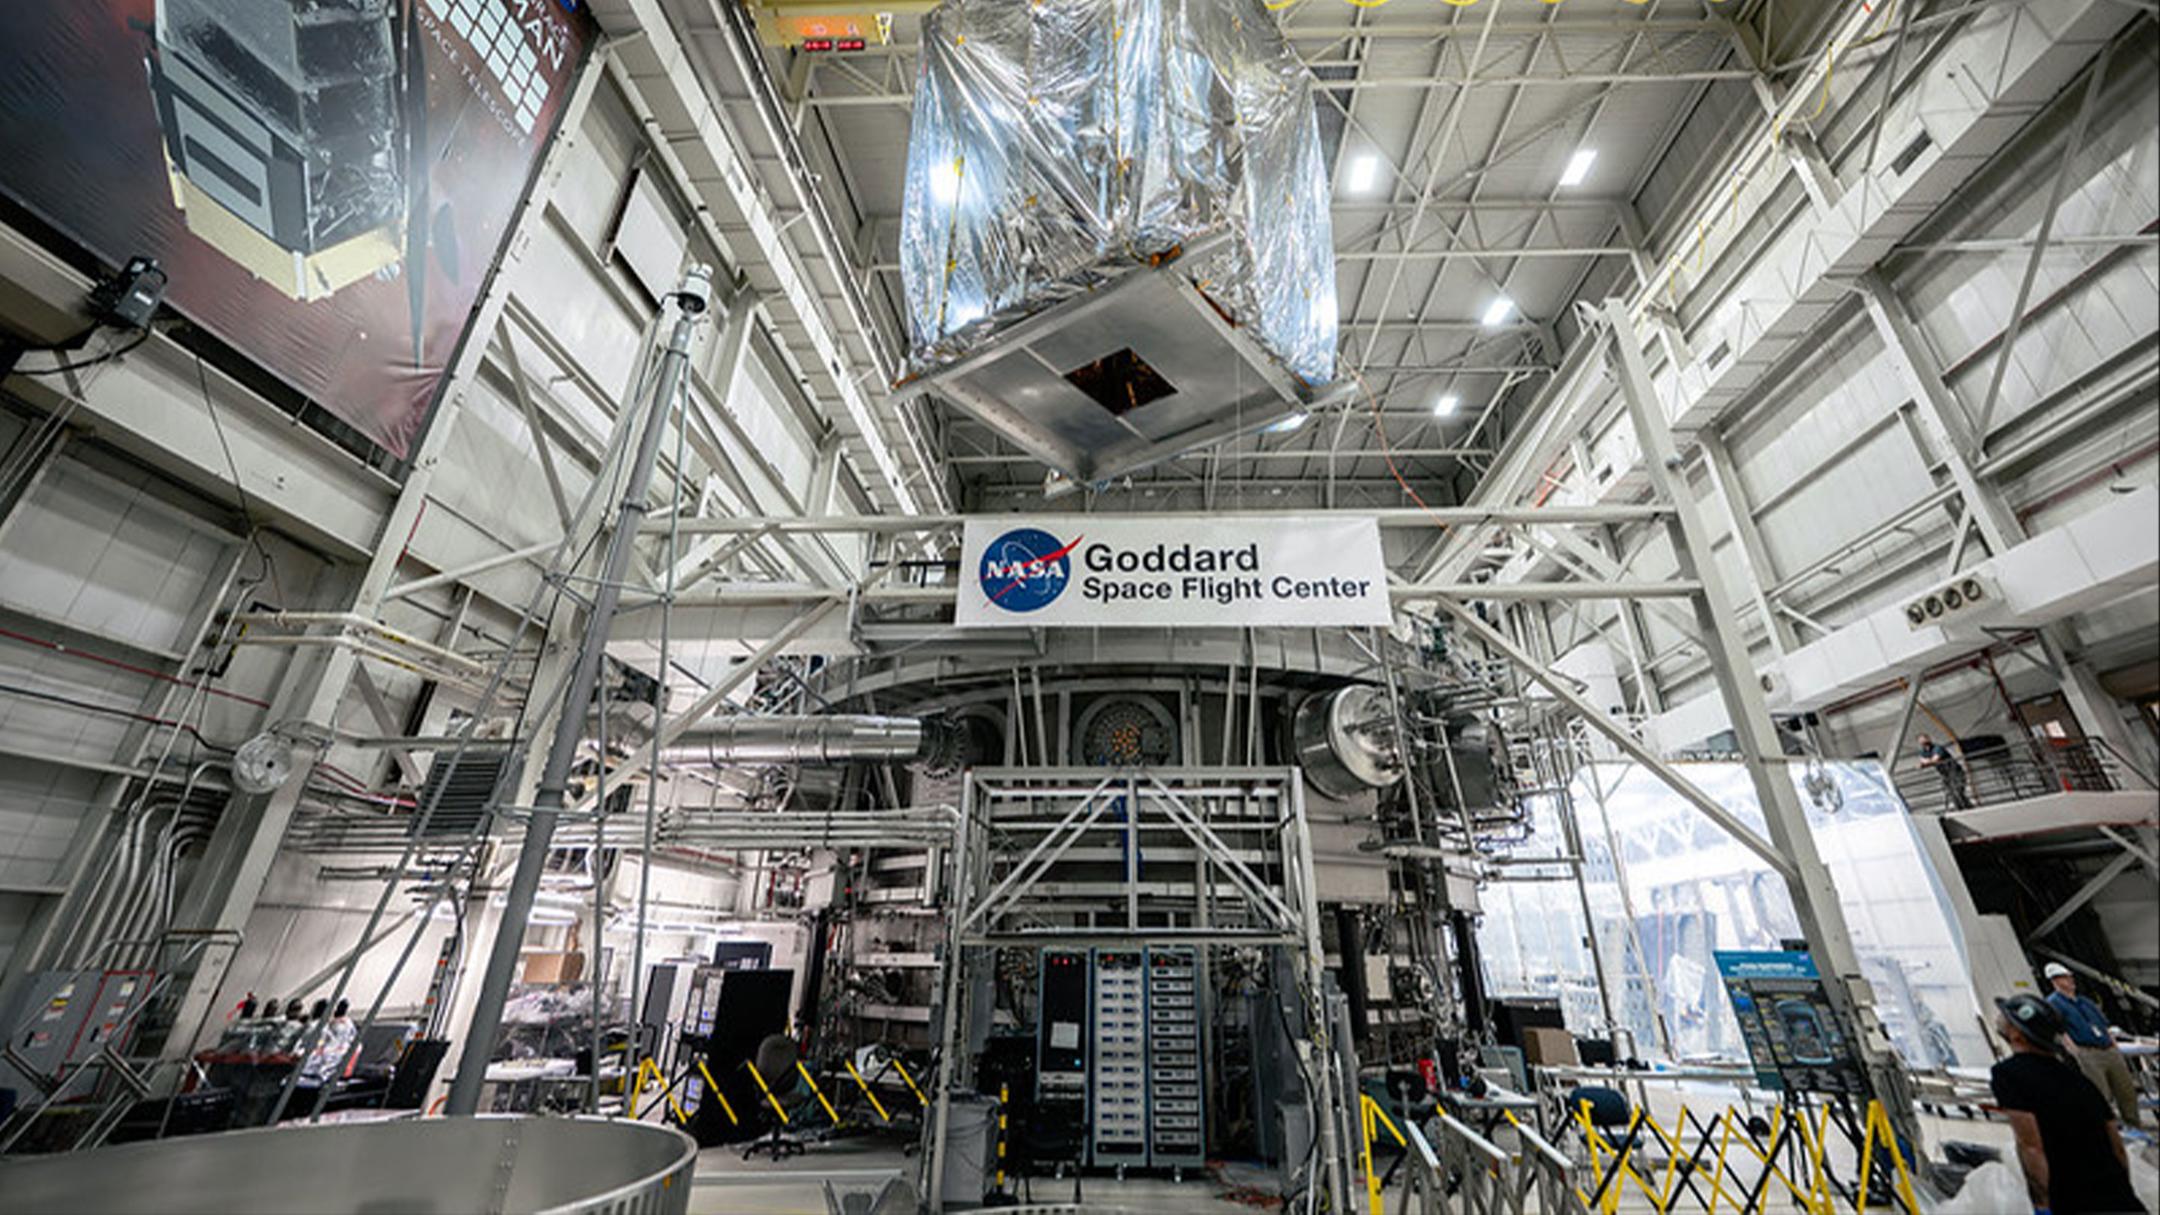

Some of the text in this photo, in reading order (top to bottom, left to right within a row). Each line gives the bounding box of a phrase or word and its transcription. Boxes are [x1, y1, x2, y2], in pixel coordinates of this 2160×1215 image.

[416, 6, 527, 150] SPACE TELESCOPE
[985, 560, 1065, 579] NASA
[1084, 543, 1258, 573] Goddard
[1082, 576, 1370, 605] Space Flight Center
